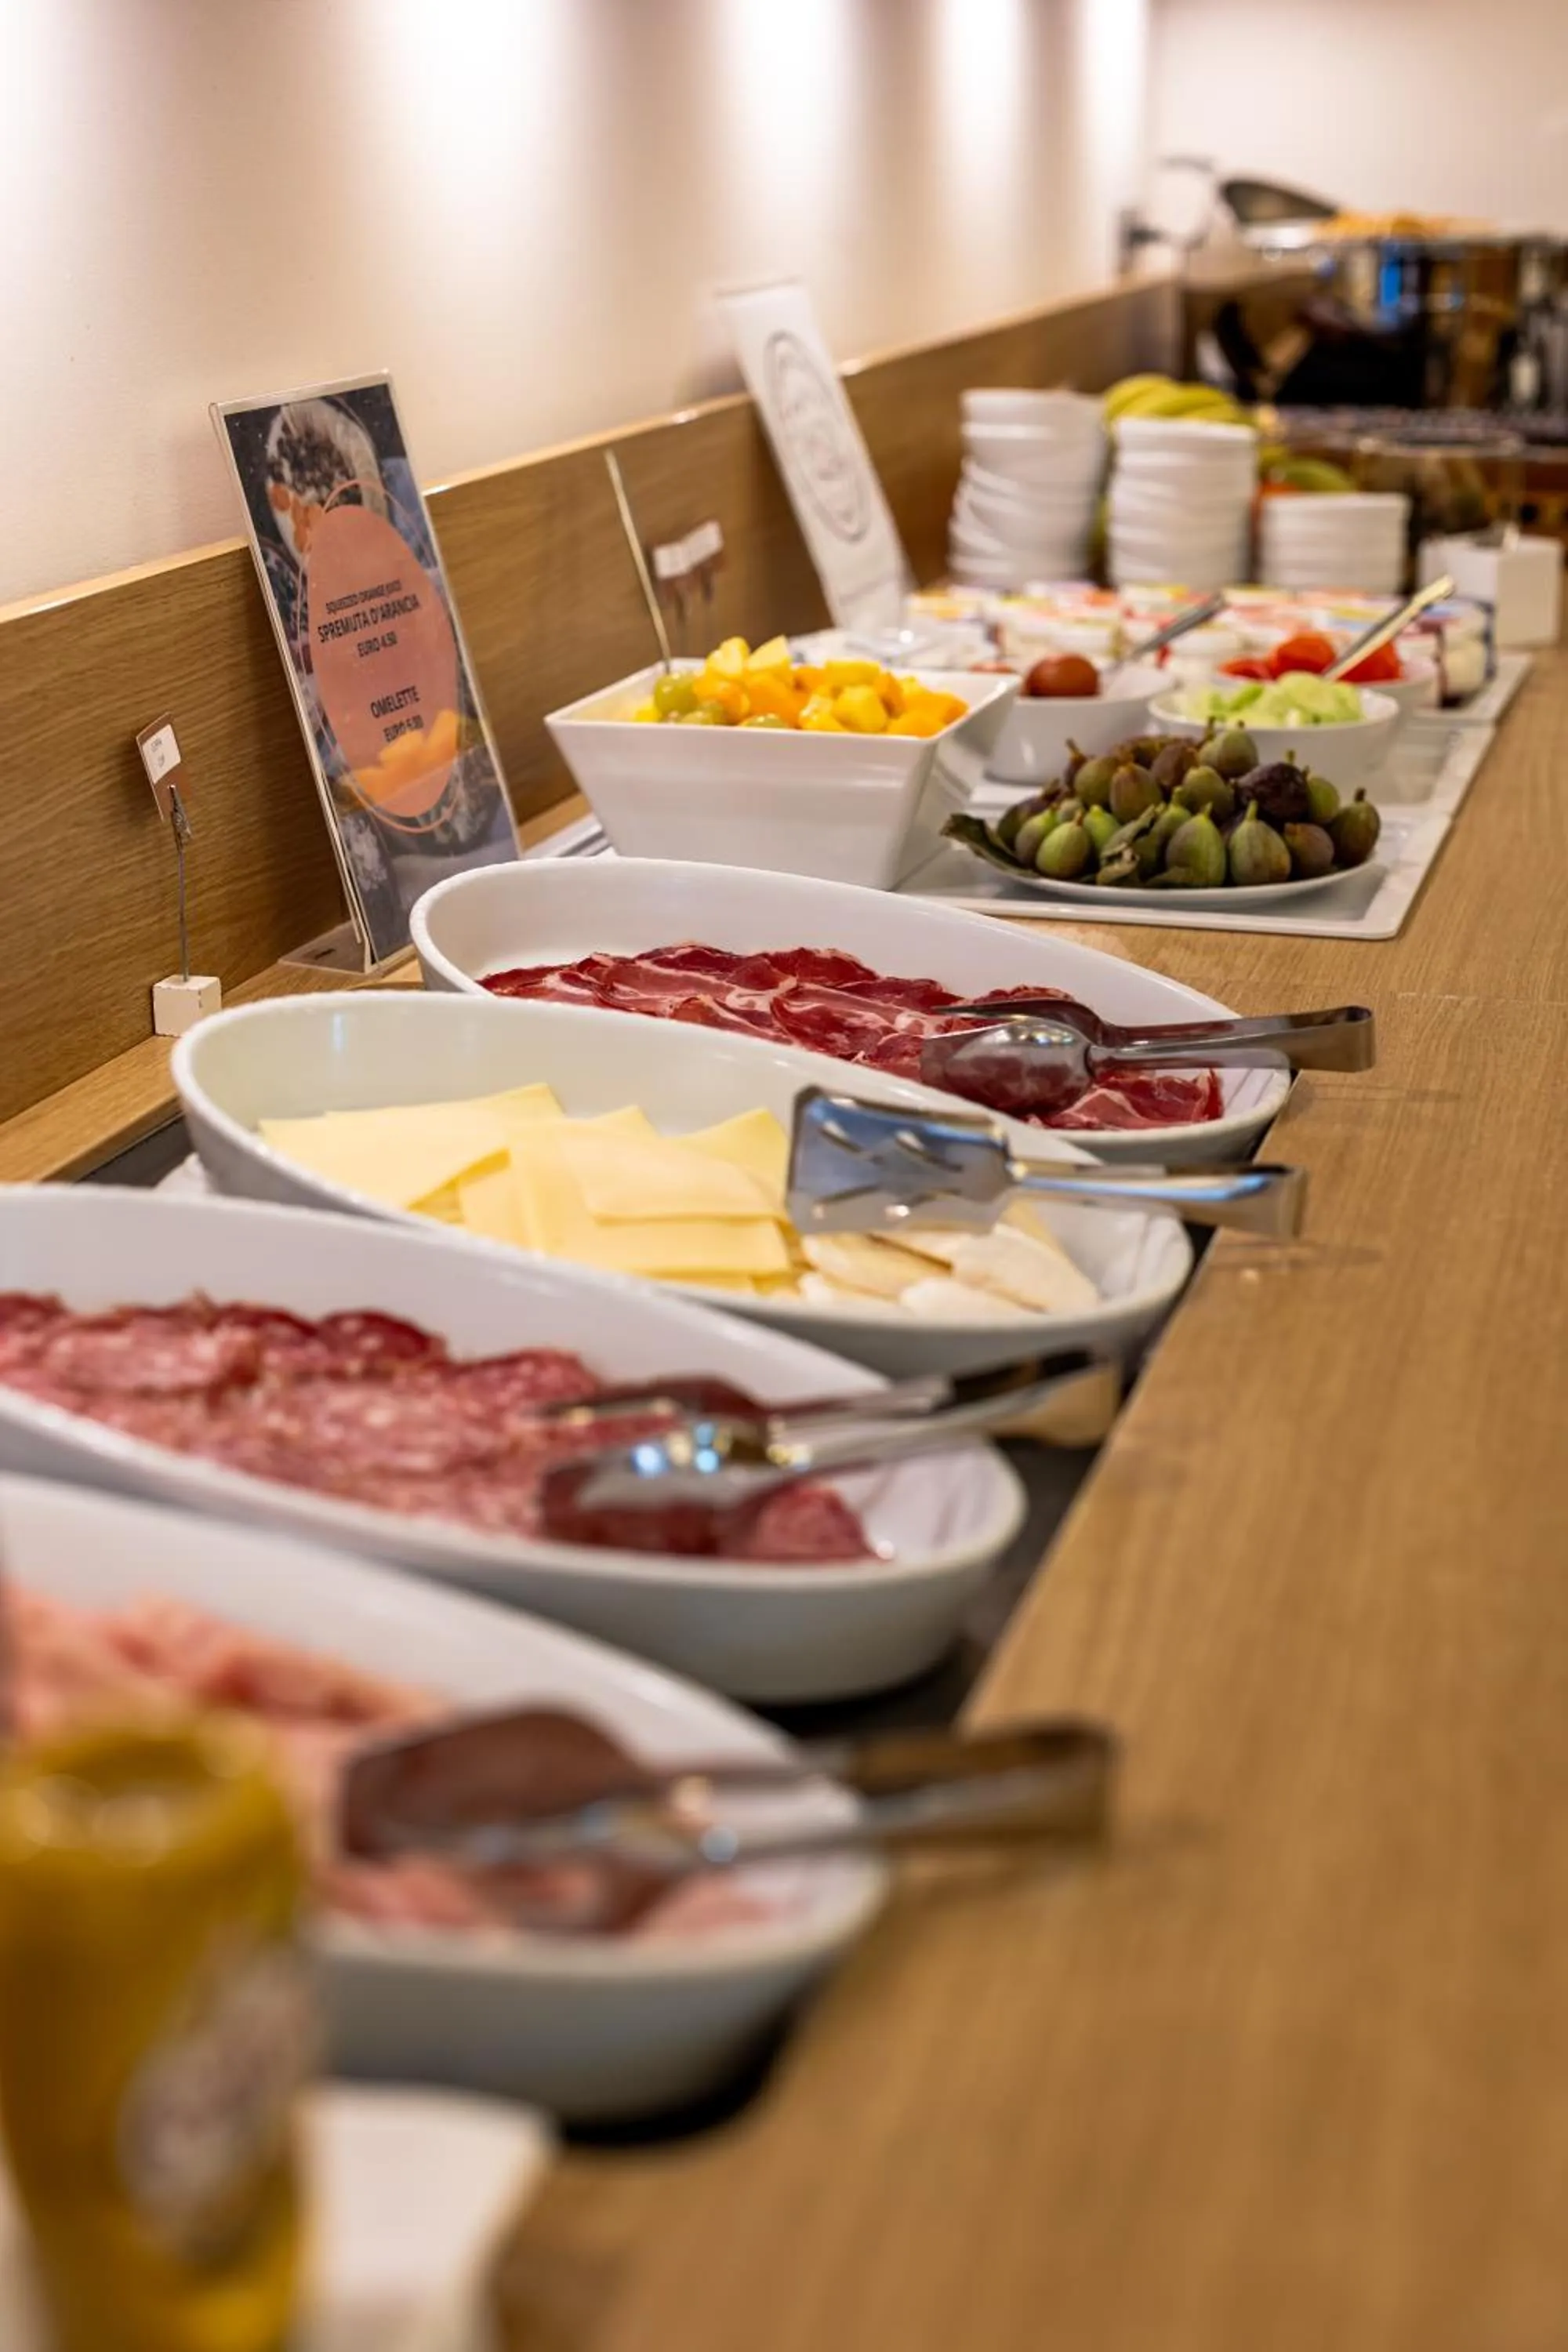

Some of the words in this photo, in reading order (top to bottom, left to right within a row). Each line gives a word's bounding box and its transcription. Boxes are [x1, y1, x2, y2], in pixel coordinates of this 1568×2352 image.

[318, 611, 370, 643] SPREMUTA
[369, 593, 420, 625] D'ARANCIA
[358, 637, 380, 658] EURO
[370, 685, 420, 719] OMELETTE
[383, 720, 406, 743] EURO
